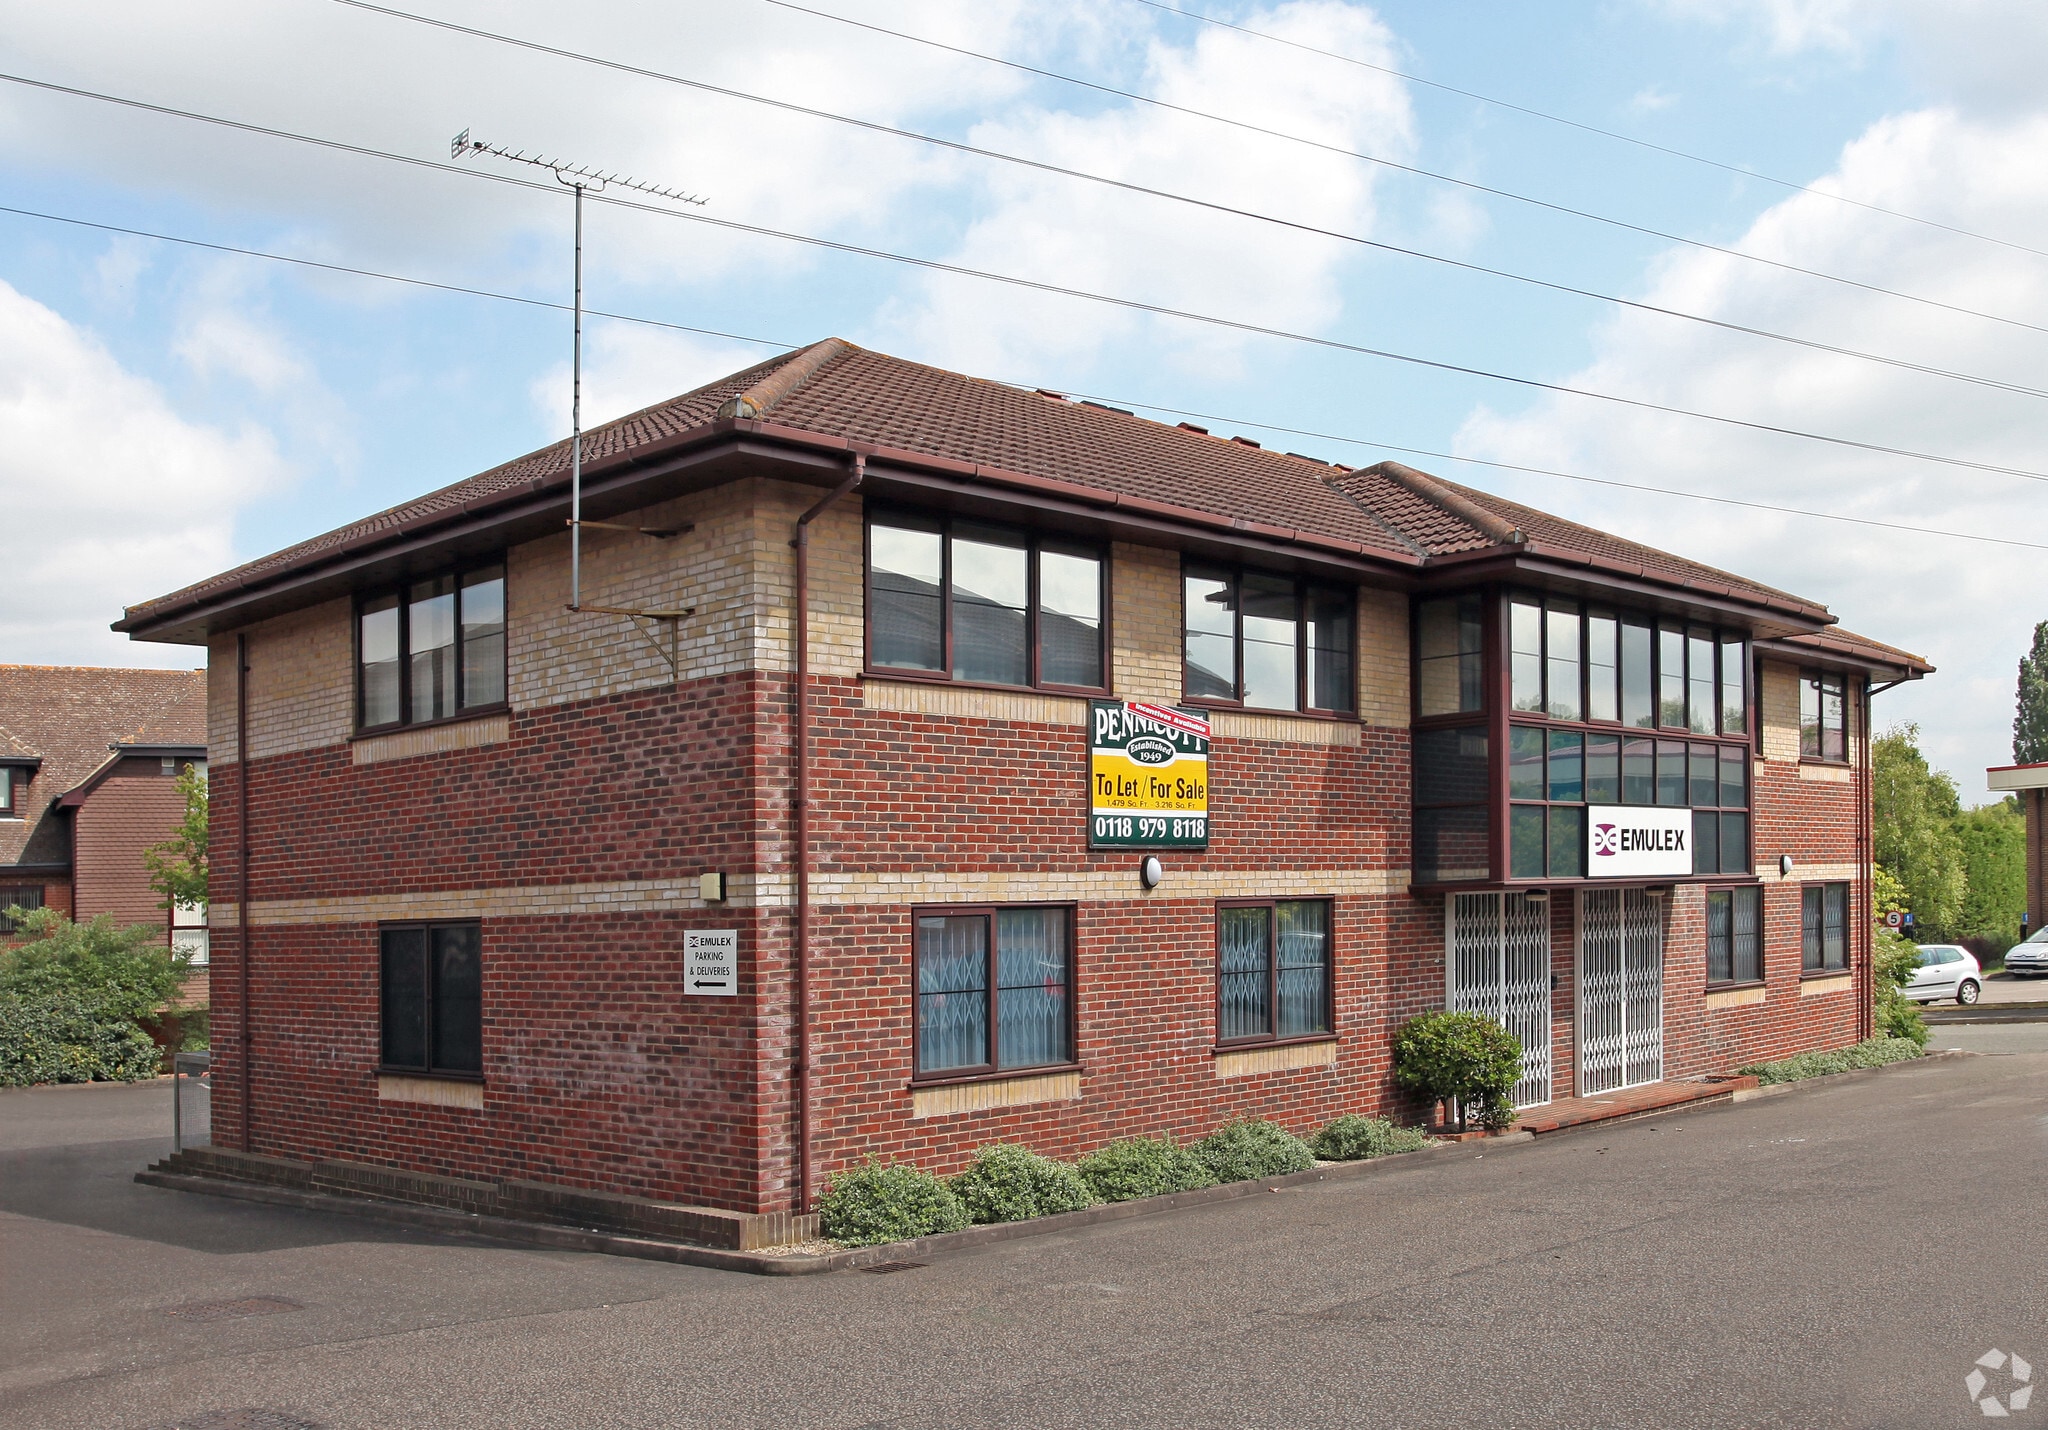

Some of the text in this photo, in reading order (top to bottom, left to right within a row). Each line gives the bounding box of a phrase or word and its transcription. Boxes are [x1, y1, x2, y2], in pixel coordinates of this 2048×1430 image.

[1135, 703, 1207, 733] Incentives Available
[1130, 740, 1172, 756] Established
[1140, 751, 1162, 762] 1949
[1095, 773, 1113, 796] To
[1116, 774, 1138, 797] Let
[1150, 777, 1172, 798] For
[1176, 777, 1204, 800] Sale
[1095, 816, 1205, 839] 0118 979 8118
[1620, 828, 1685, 851] EMULEX
[1890, 914, 1898, 924] 5
[700, 937, 731, 946] EMULEX
[695, 951, 724, 961] PARKING
[689, 966, 730, 976] & DELIVERIES
